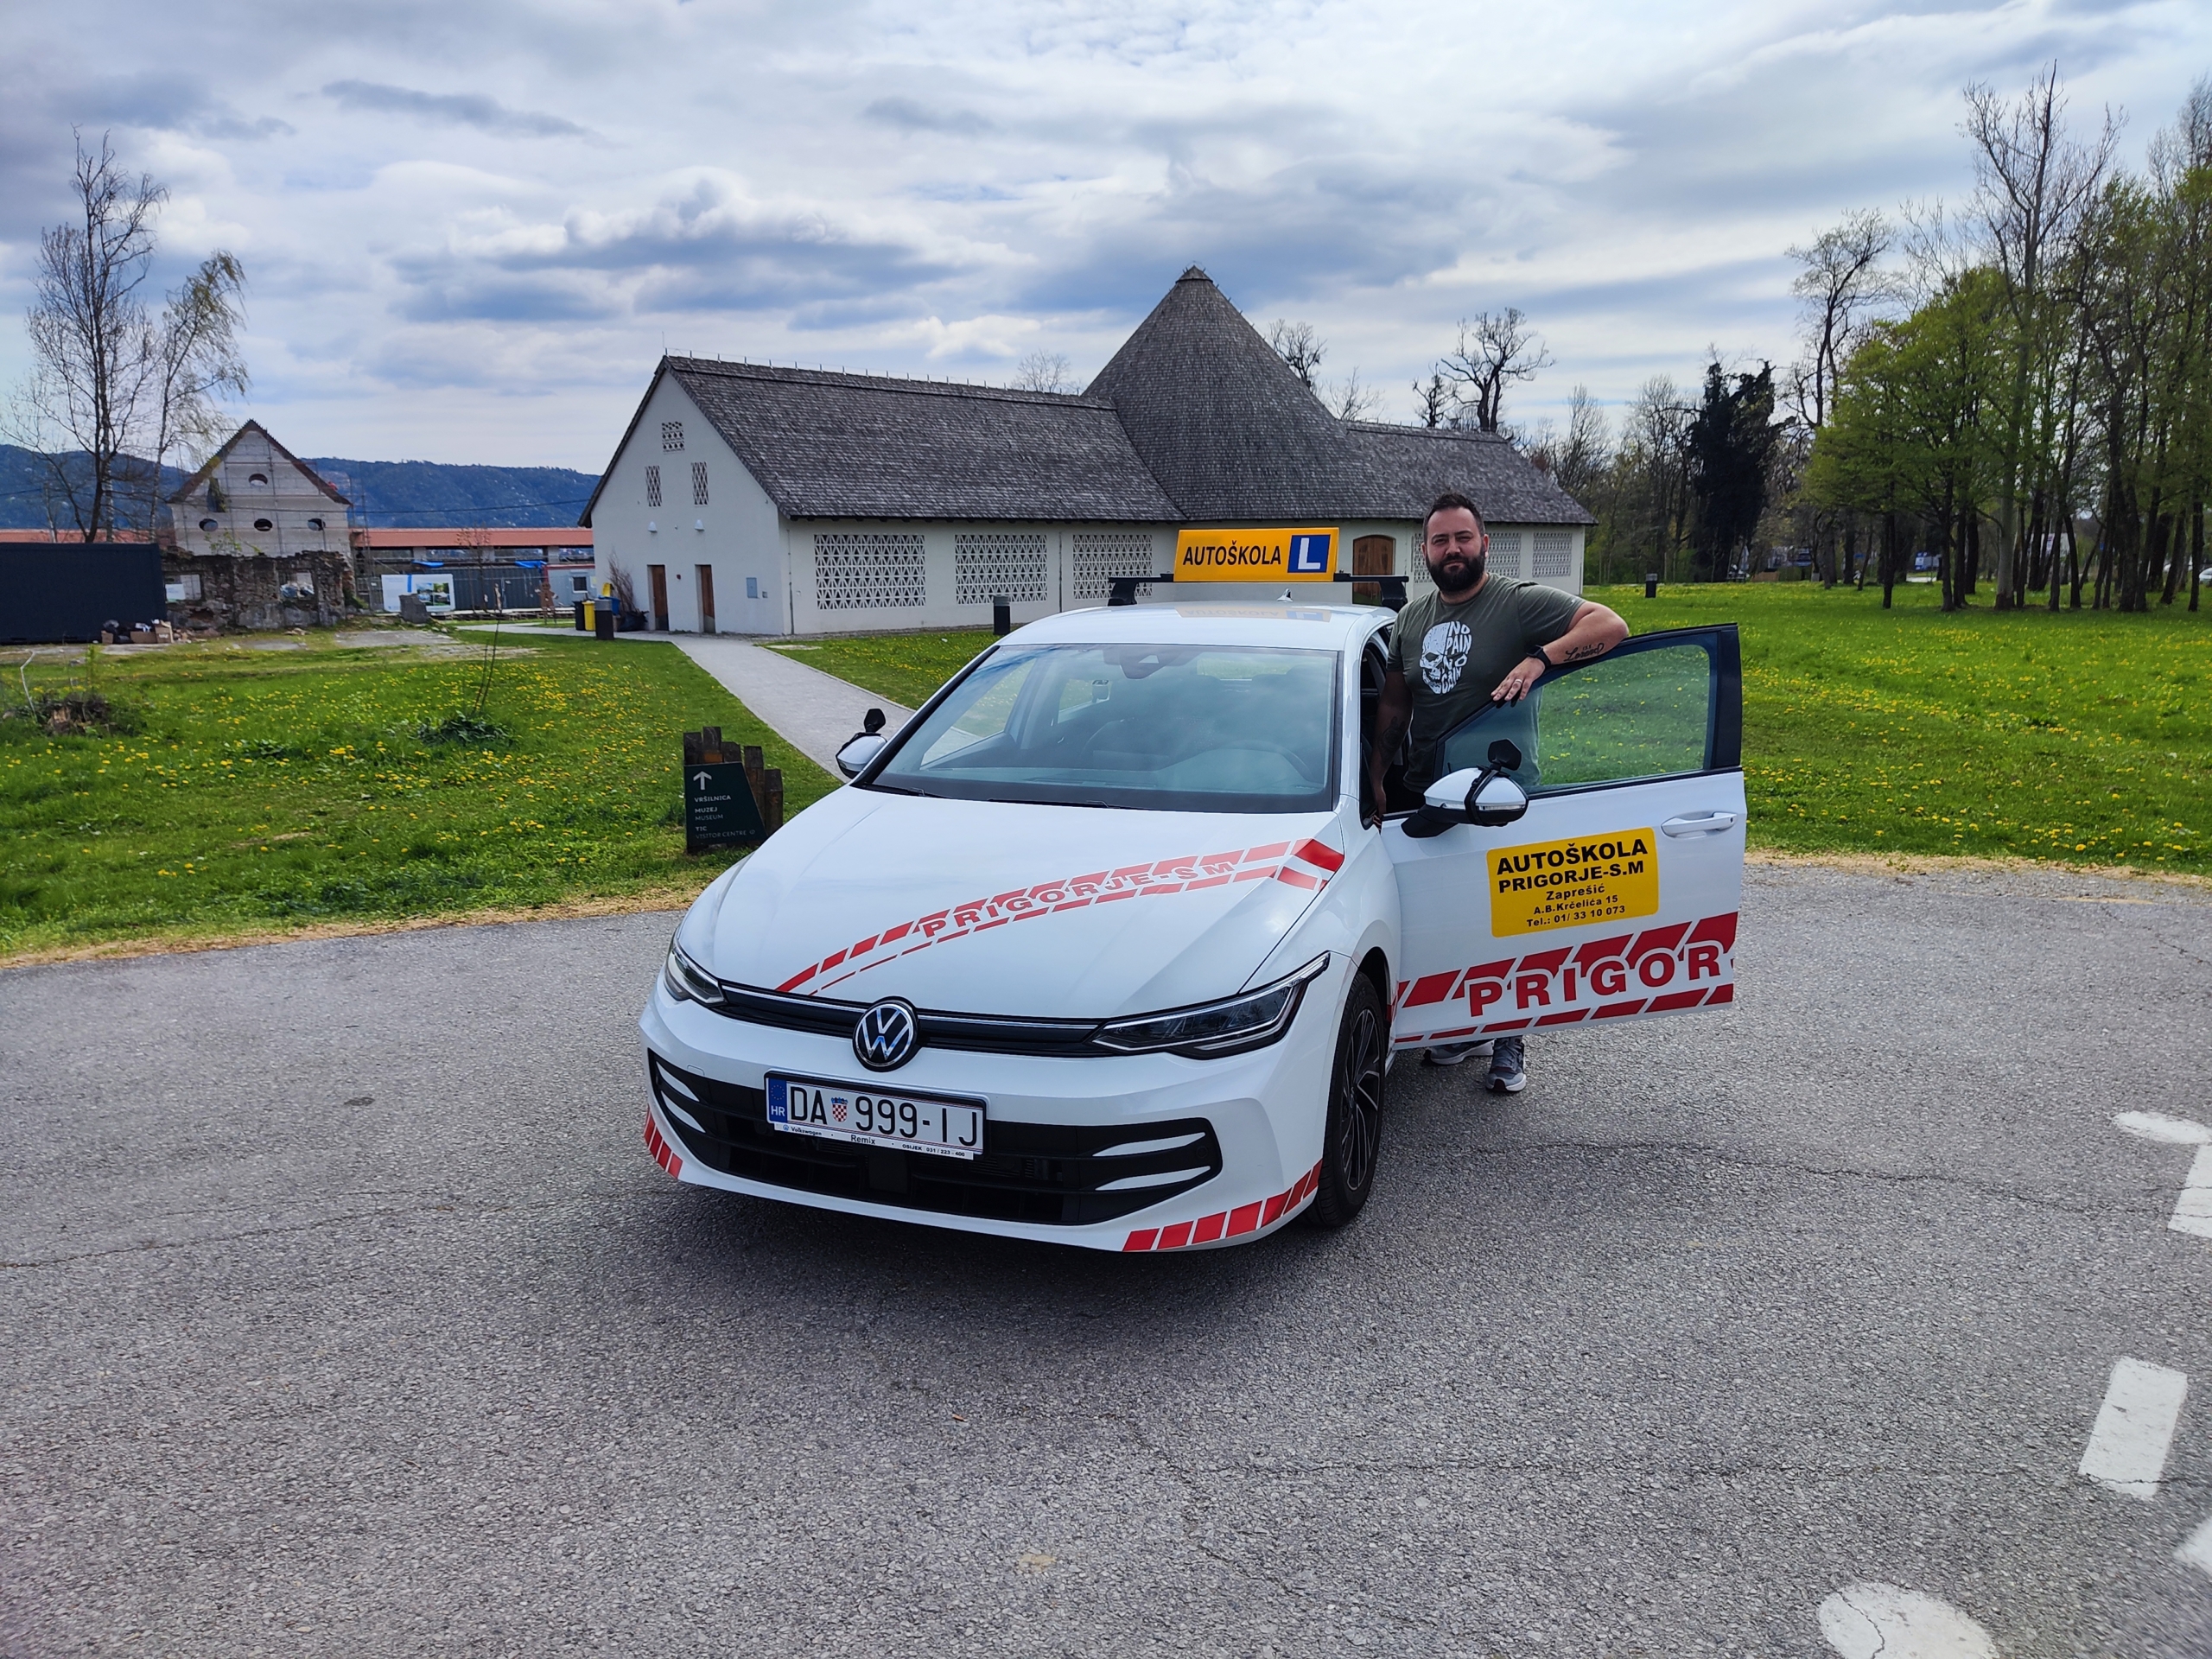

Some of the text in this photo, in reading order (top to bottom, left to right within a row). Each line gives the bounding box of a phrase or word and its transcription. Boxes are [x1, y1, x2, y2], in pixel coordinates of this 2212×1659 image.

[1182, 537, 1320, 570] AUTOŠKOLA L
[1448, 620, 1471, 637] NO
[1445, 633, 1472, 656] PAIN
[1440, 666, 1463, 695] GAIN
[1497, 838, 1648, 875] AUTOŠKOLA
[1498, 861, 1644, 893] PRIGORJE-S.M
[1546, 883, 1605, 901] Zaprešić
[1527, 905, 1625, 927] Tel.: 01/ 33 10 073
[1533, 894, 1618, 915] A.B.Krčelića 15
[1469, 944, 1734, 1018] PRIGOR
[771, 1105, 785, 1117] HR
[790, 1085, 828, 1125] DA
[791, 1126, 822, 1136] Volkswagen
[850, 1134, 876, 1145] Remix
